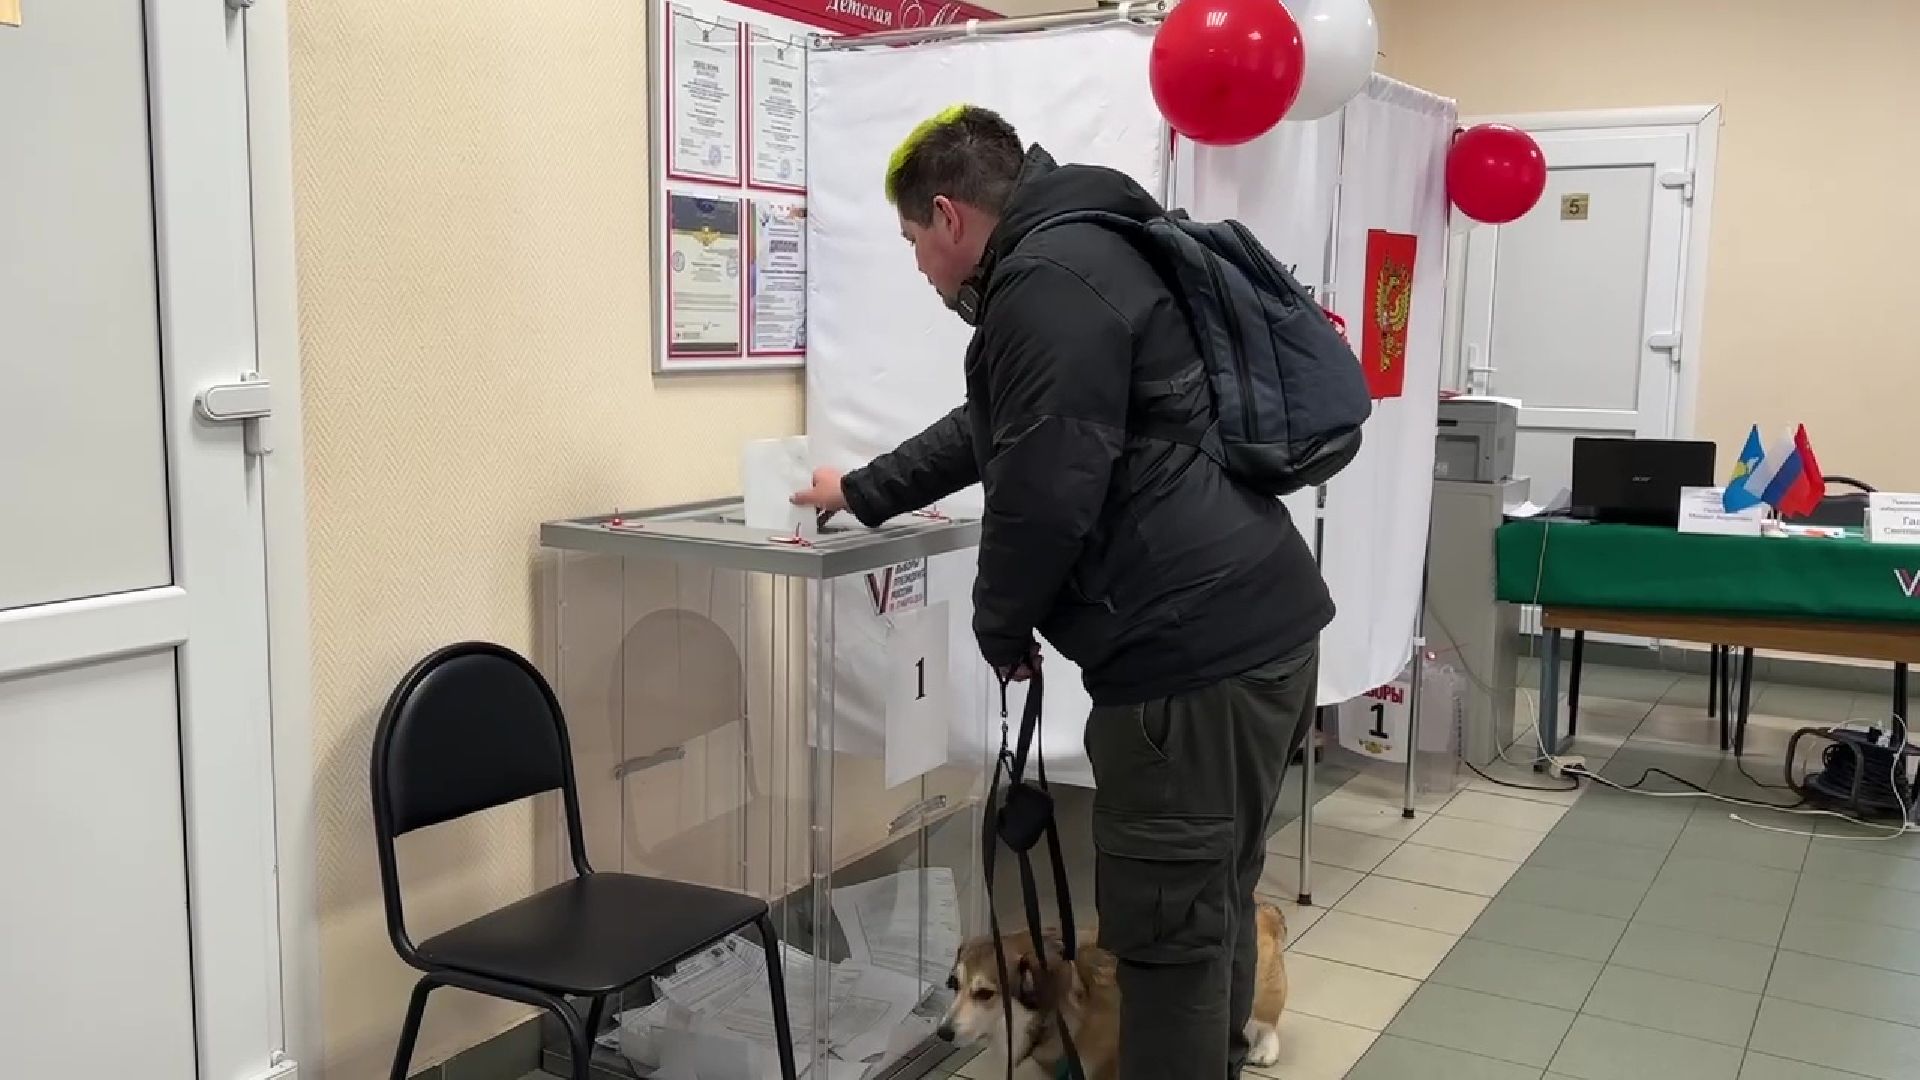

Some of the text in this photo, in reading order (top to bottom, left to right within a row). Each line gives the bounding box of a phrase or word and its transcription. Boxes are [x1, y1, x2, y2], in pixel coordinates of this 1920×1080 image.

[825, 0, 892, 26] Детская
[1569, 198, 1580, 215] 5
[914, 656, 927, 701] 1
[1368, 702, 1390, 740] 1
